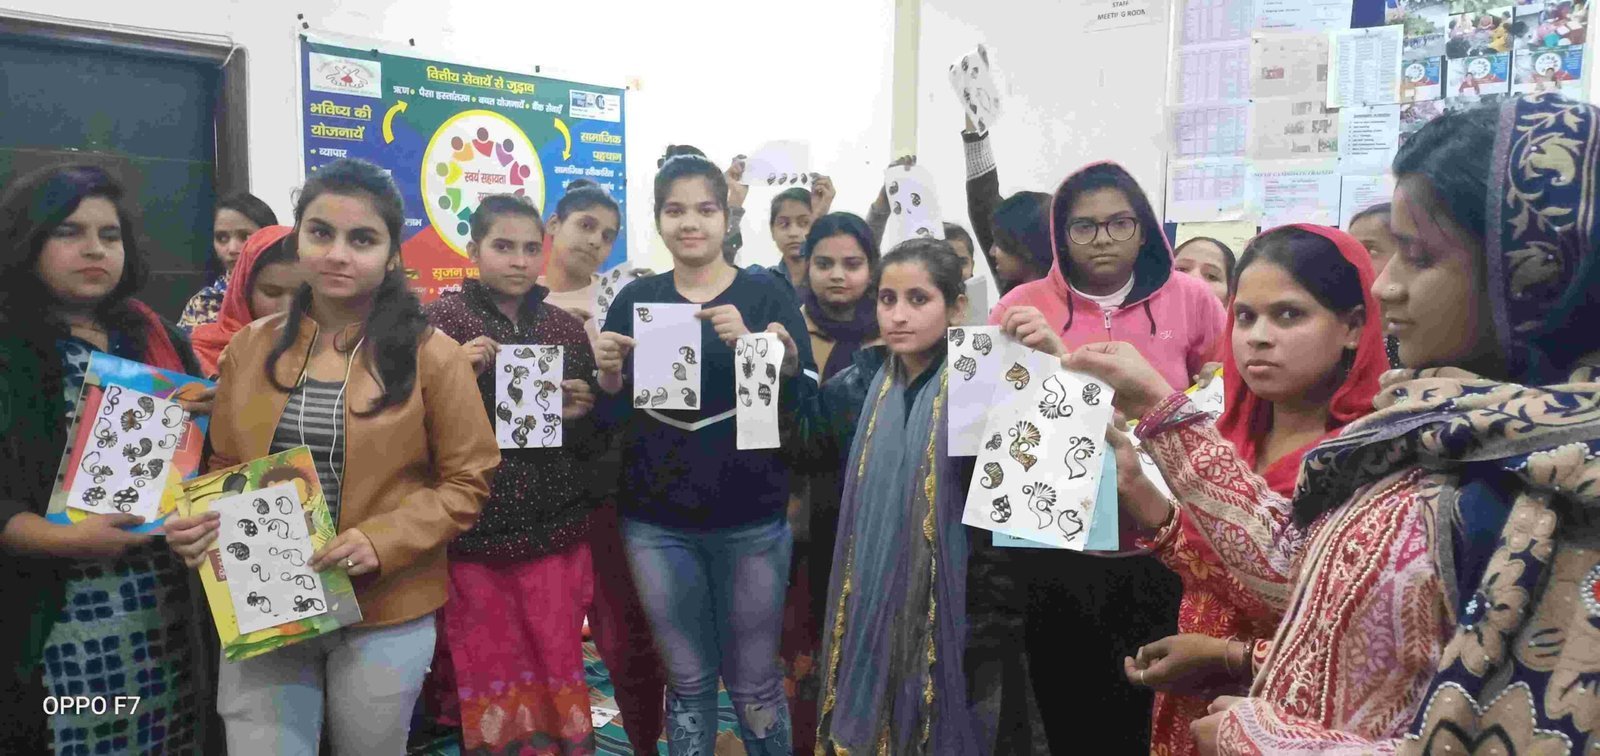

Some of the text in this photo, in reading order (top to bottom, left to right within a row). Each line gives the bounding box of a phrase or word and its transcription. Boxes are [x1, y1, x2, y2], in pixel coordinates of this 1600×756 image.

[426, 66, 460, 82] वित्तीय
[494, 77, 504, 89] से
[506, 80, 535, 94] जुड़ाव
[393, 85, 410, 95] ऋण
[419, 86, 434, 98] पैसा
[310, 100, 372, 119] भविष्य की
[310, 122, 366, 139] योजनायें
[580, 131, 622, 144] सामाजिक
[319, 147, 348, 158] व्यापार
[464, 169, 506, 184] स्वयं सहायता
[432, 267, 464, 281] सृजन
